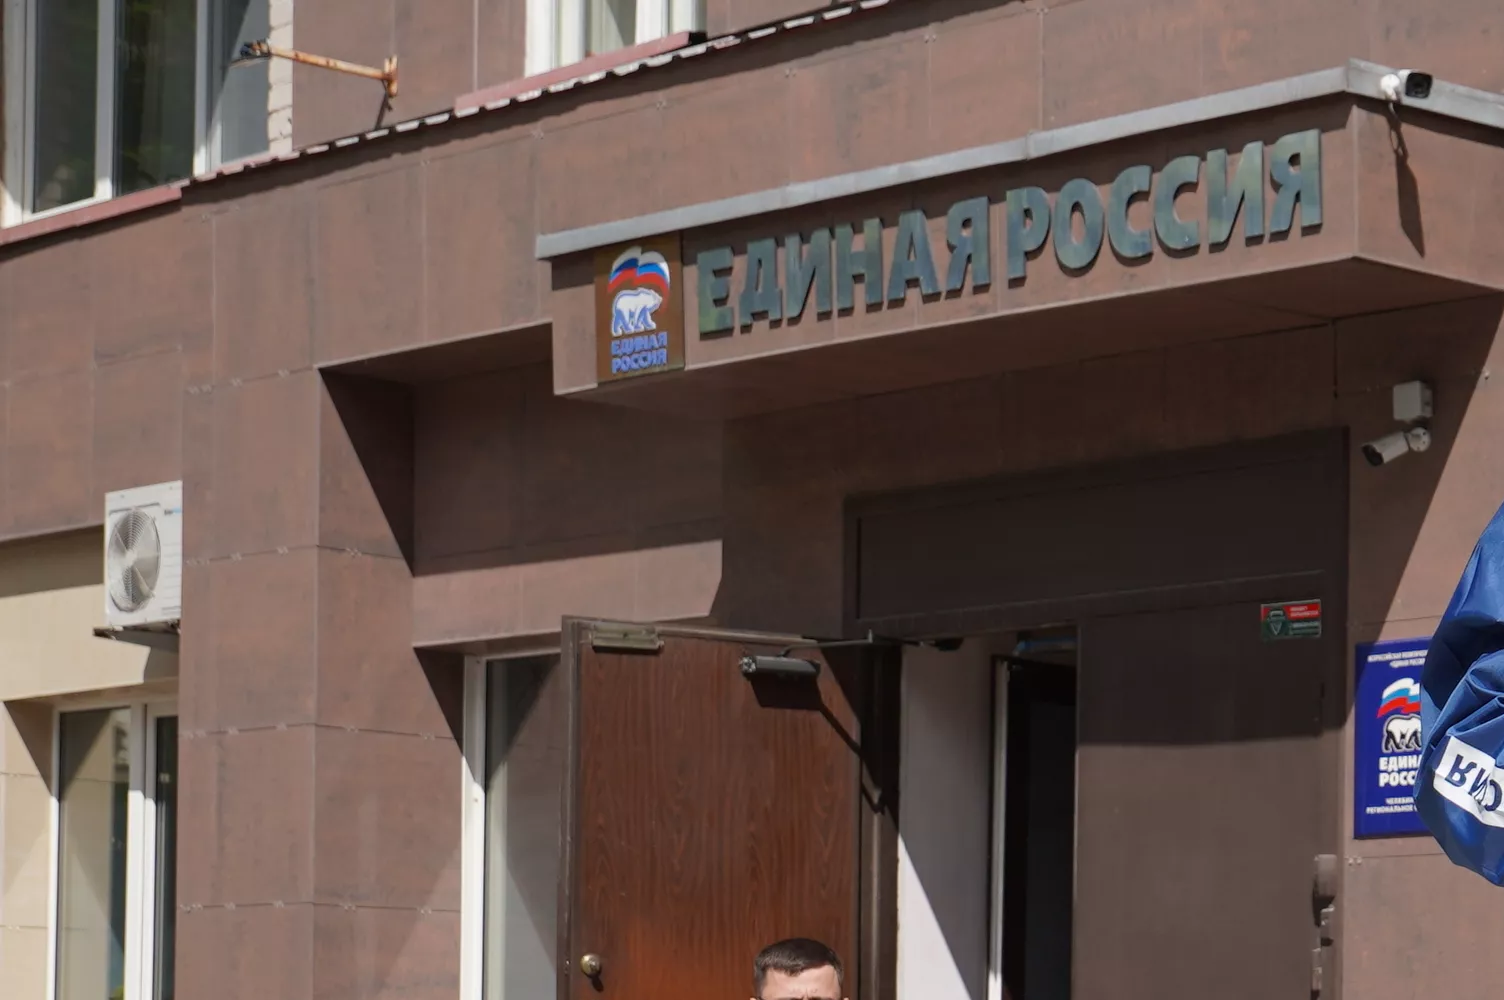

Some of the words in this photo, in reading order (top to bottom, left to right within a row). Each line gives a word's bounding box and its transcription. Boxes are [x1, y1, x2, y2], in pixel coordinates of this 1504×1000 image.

[697, 196, 991, 335] ЕДИНАЯ
[1005, 129, 1323, 282] РОССИЯ
[611, 331, 668, 356] ЕДИНАЯ
[611, 348, 668, 374] РОССИЯ
[1378, 754, 1421, 773] ЕДИН
[1378, 770, 1417, 788] РОСС
